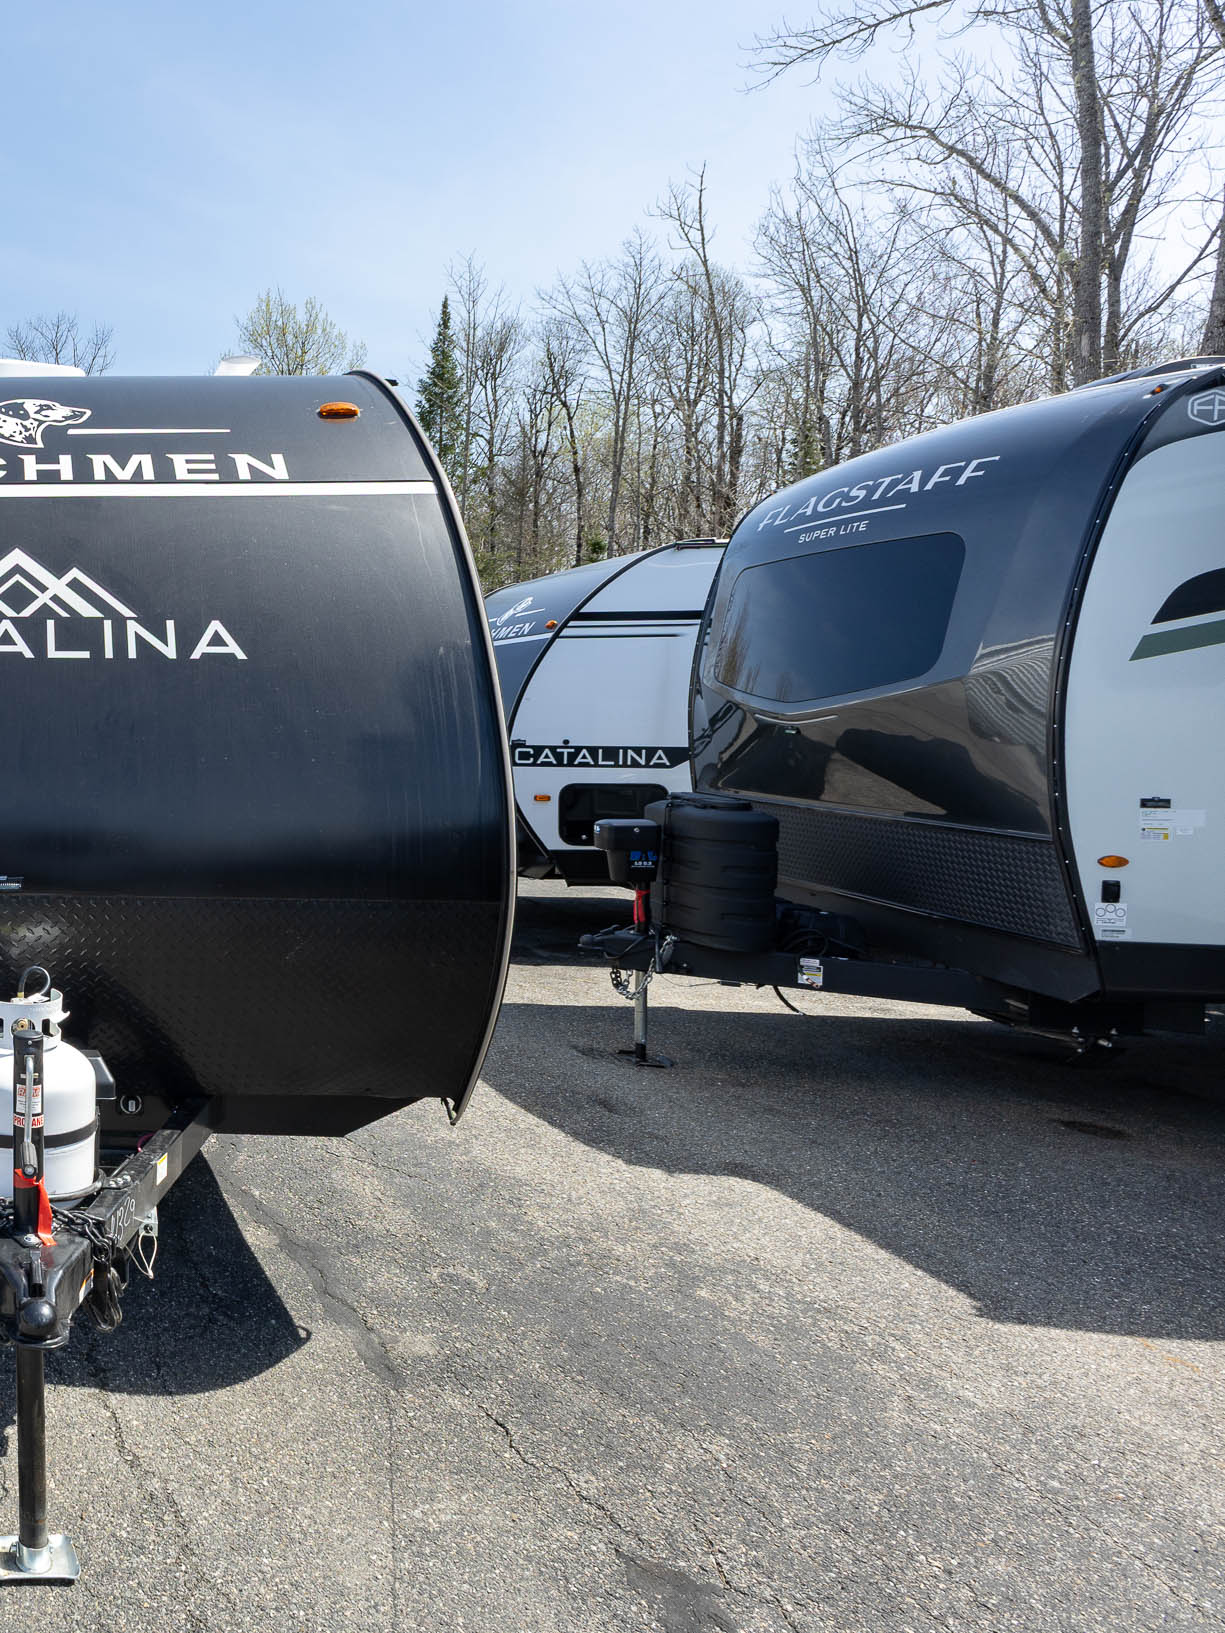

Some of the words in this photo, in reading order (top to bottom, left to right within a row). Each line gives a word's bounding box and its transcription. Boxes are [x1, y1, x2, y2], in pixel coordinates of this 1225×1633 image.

[757, 455, 1001, 532] FLAGSTAFF
[798, 526, 837, 544] SUPER
[839, 520, 870, 536] LITE
[514, 748, 671, 766] CATALINA
[14, 1115, 44, 1127] PROANE
